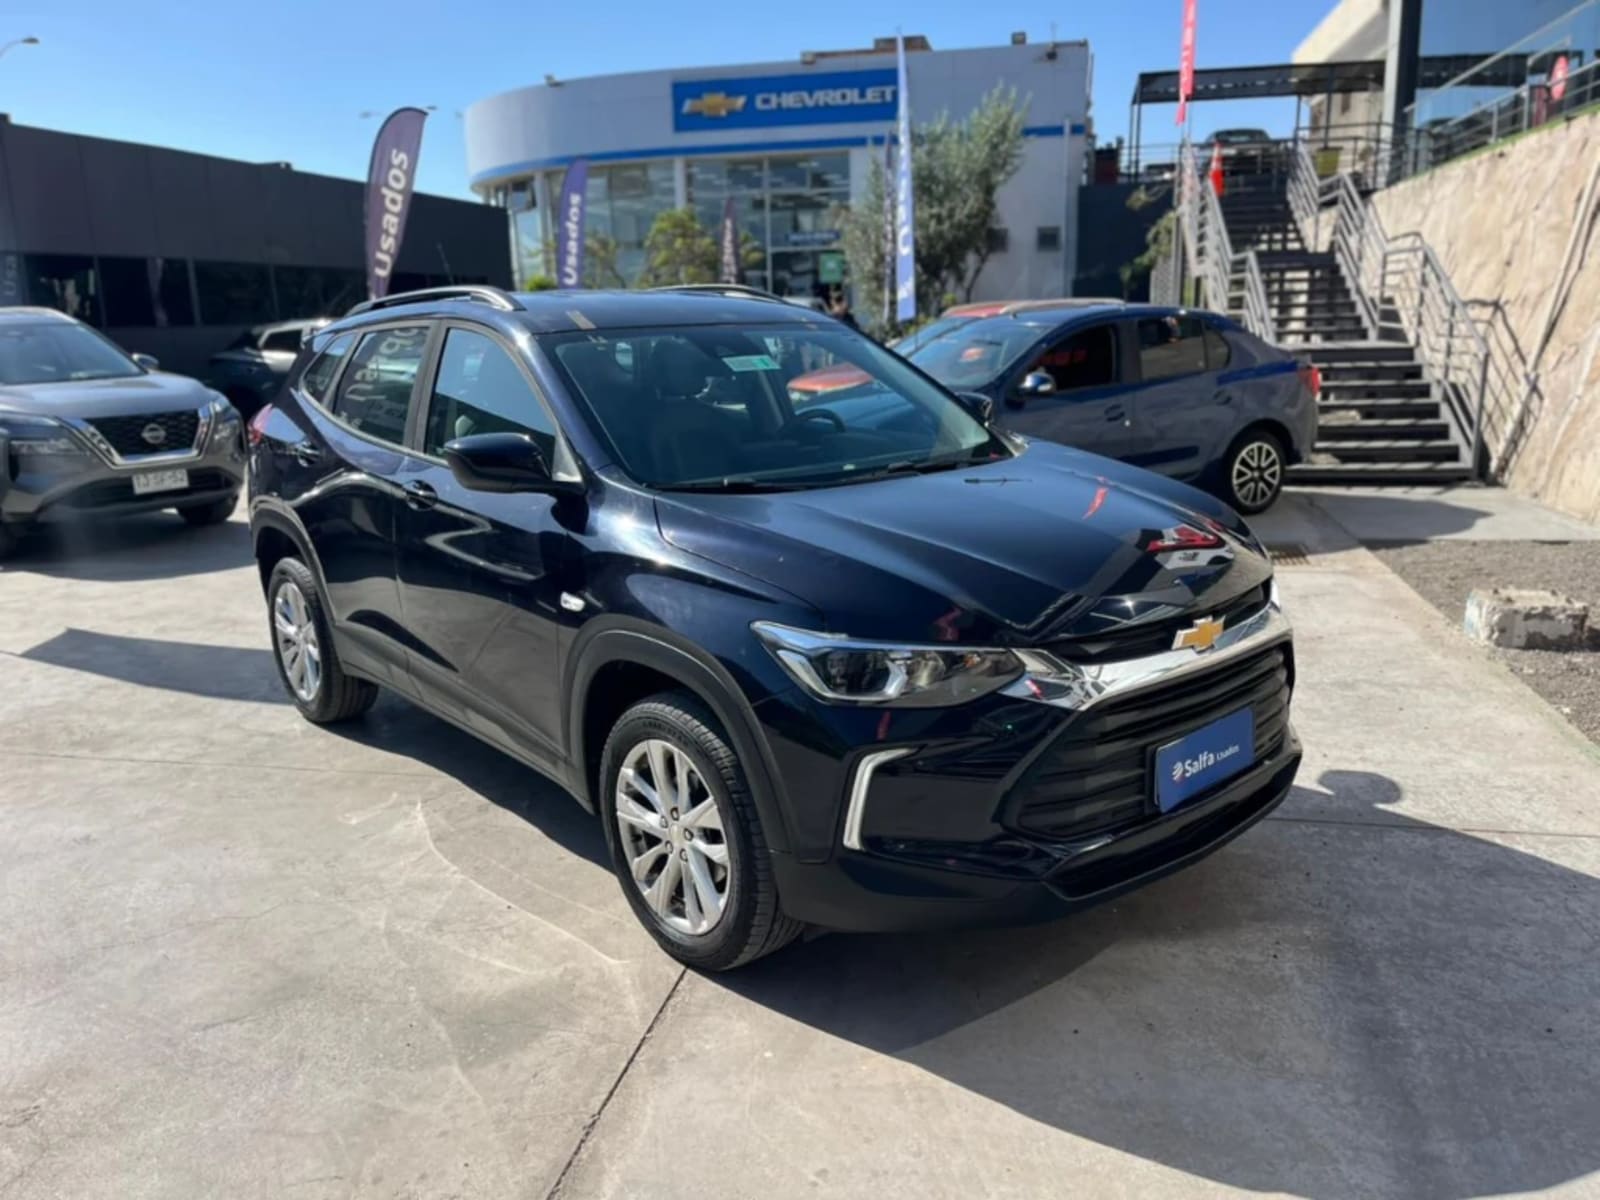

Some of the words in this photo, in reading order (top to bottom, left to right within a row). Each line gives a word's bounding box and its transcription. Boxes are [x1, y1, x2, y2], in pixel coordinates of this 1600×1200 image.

[754, 85, 897, 111] CHEVROLET
[374, 149, 408, 278] Usados
[563, 193, 581, 285] Usados
[1184, 751, 1215, 778] Salfa
